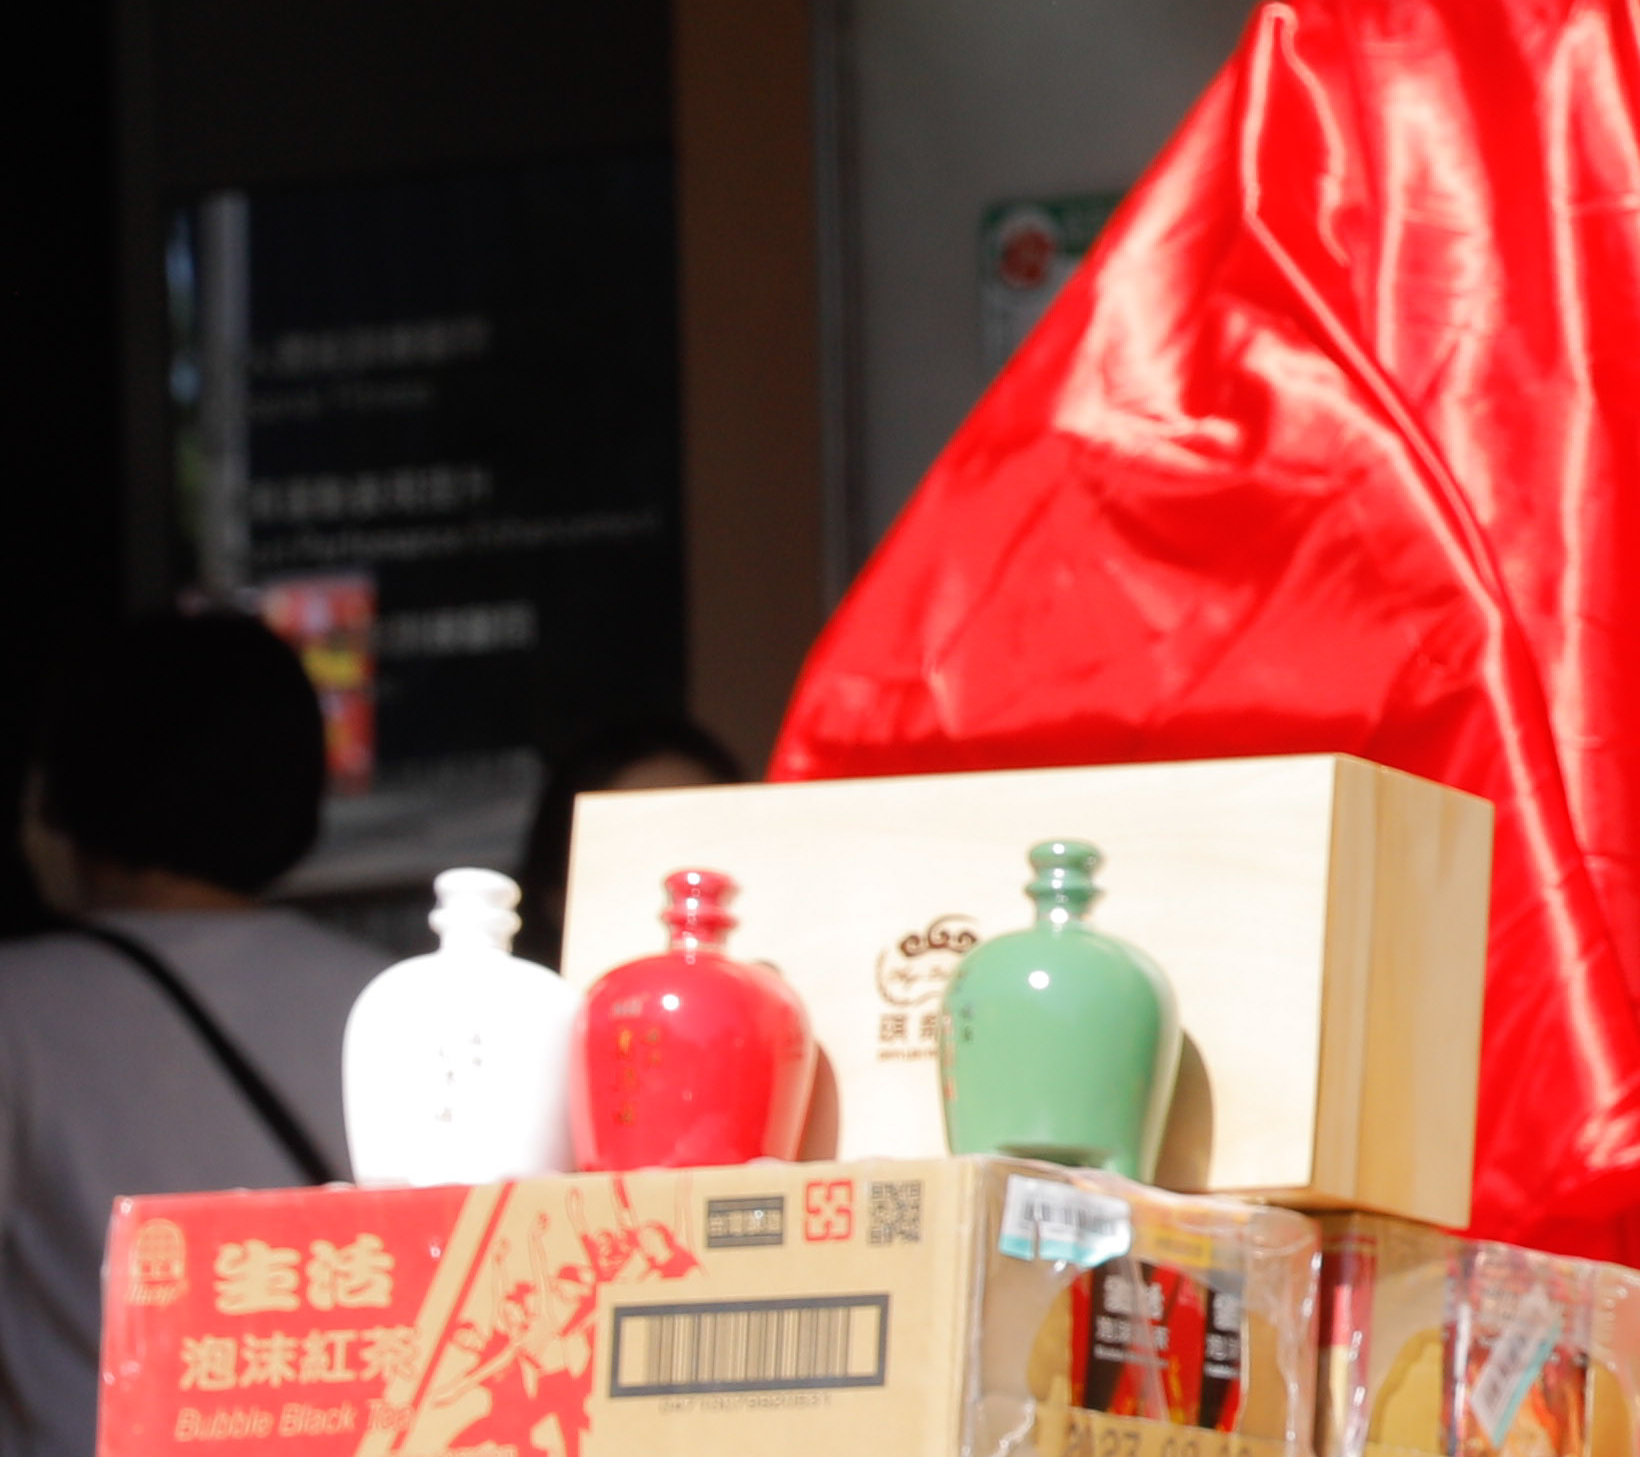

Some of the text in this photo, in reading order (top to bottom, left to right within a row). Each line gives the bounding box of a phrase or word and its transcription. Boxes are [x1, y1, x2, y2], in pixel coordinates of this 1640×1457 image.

[213, 1232, 394, 1314] 生活
[180, 1325, 421, 1390] 泡沫紅茶
[175, 1399, 414, 1441] Bubble Black Tea
